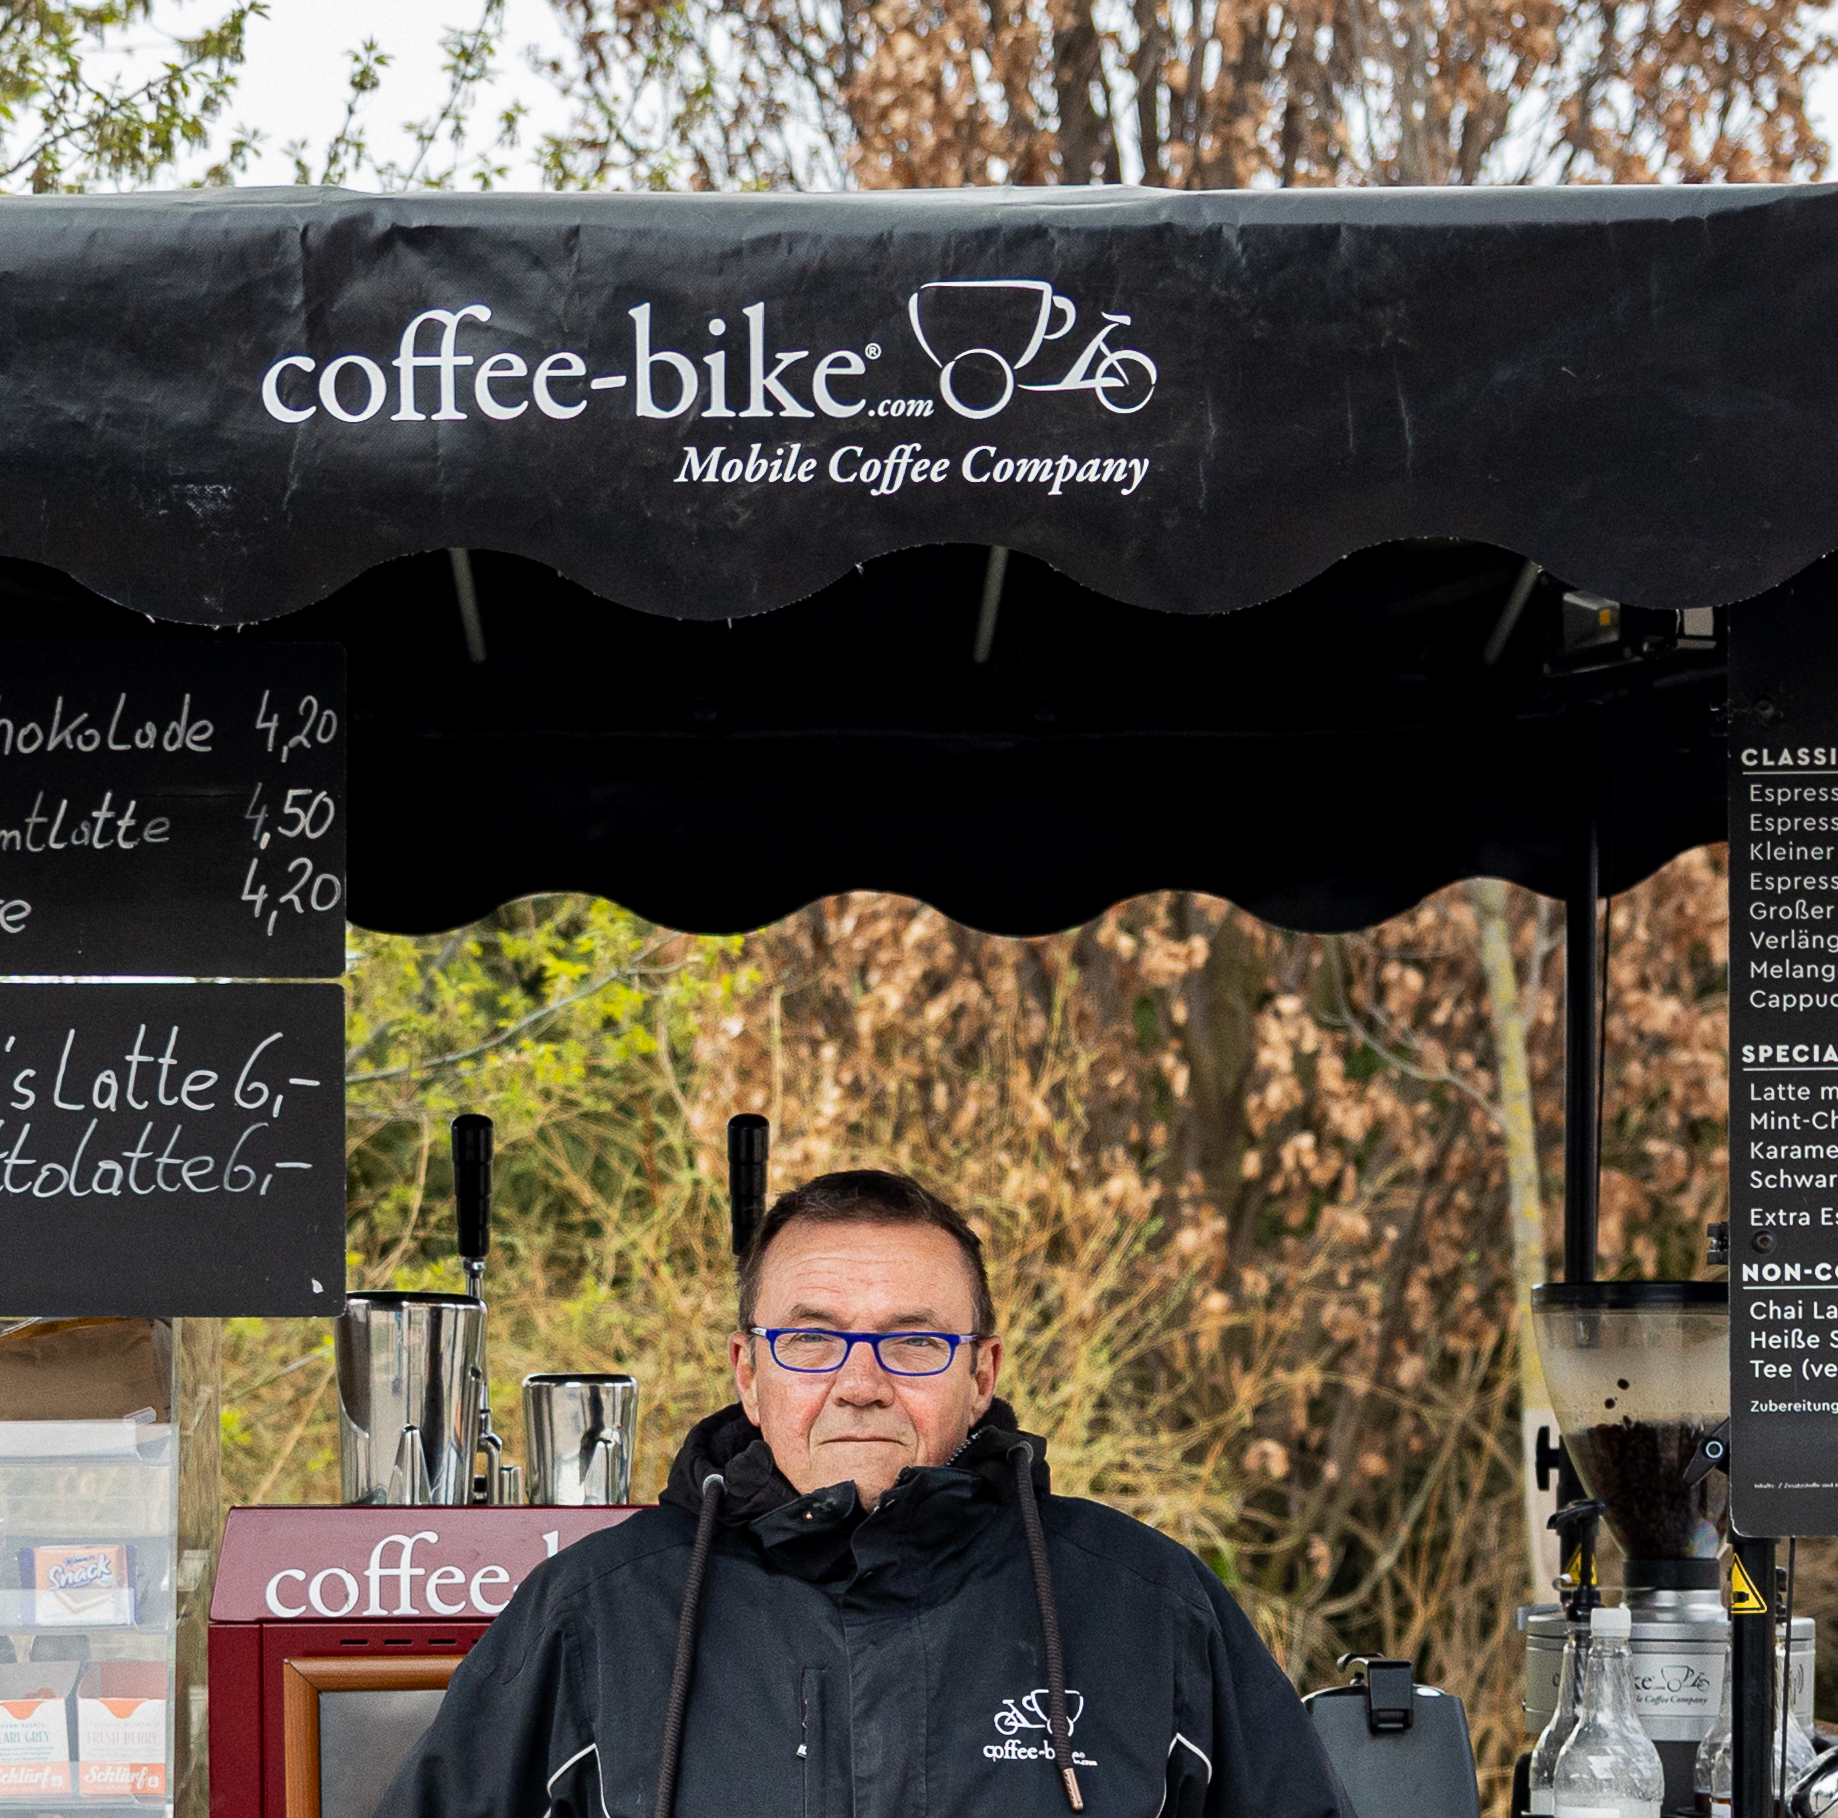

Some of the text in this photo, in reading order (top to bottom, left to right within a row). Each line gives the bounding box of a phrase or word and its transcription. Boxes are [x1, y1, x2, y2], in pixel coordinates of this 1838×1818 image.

[673, 444, 1150, 497] Mobile Coffee Company
[255, 690, 339, 762] 4,20
[245, 784, 336, 849] 4,50
[1750, 840, 1835, 861] Kleiner
[240, 858, 342, 935] 4,20
[1749, 898, 1832, 921] Großer
[52, 1024, 219, 1111] Latte
[1750, 1082, 1811, 1102] Latte
[1750, 1207, 1811, 1227] Extra
[1749, 1299, 1803, 1321] Chai
[1750, 1327, 1821, 1350] Heiße
[1749, 1359, 1793, 1379] Tee
[48, 1553, 111, 1591] Snack
